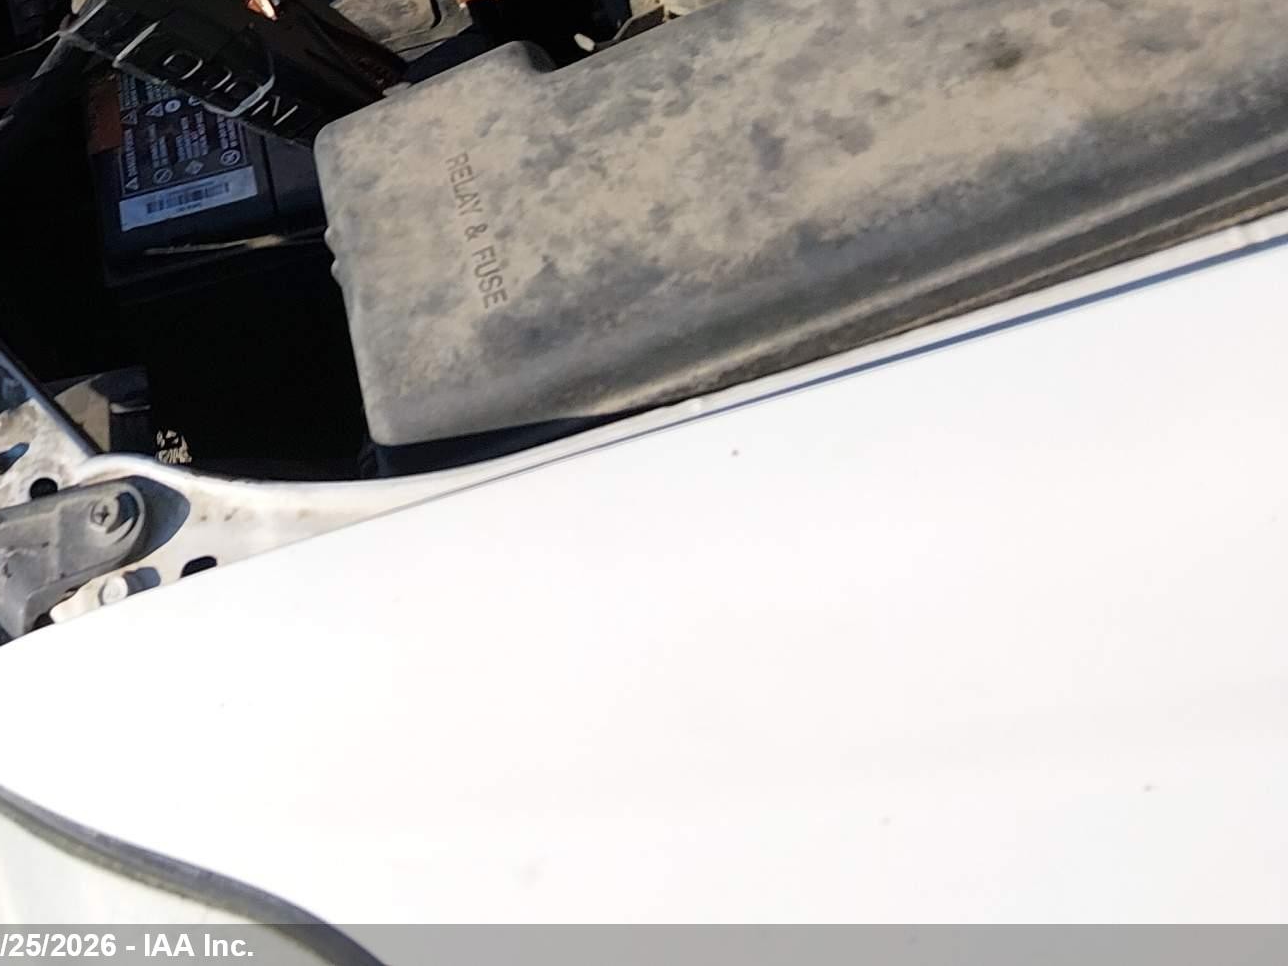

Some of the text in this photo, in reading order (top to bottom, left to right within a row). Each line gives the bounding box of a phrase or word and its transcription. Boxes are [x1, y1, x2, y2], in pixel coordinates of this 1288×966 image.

[445, 151, 509, 309] RELAY & FUSE
